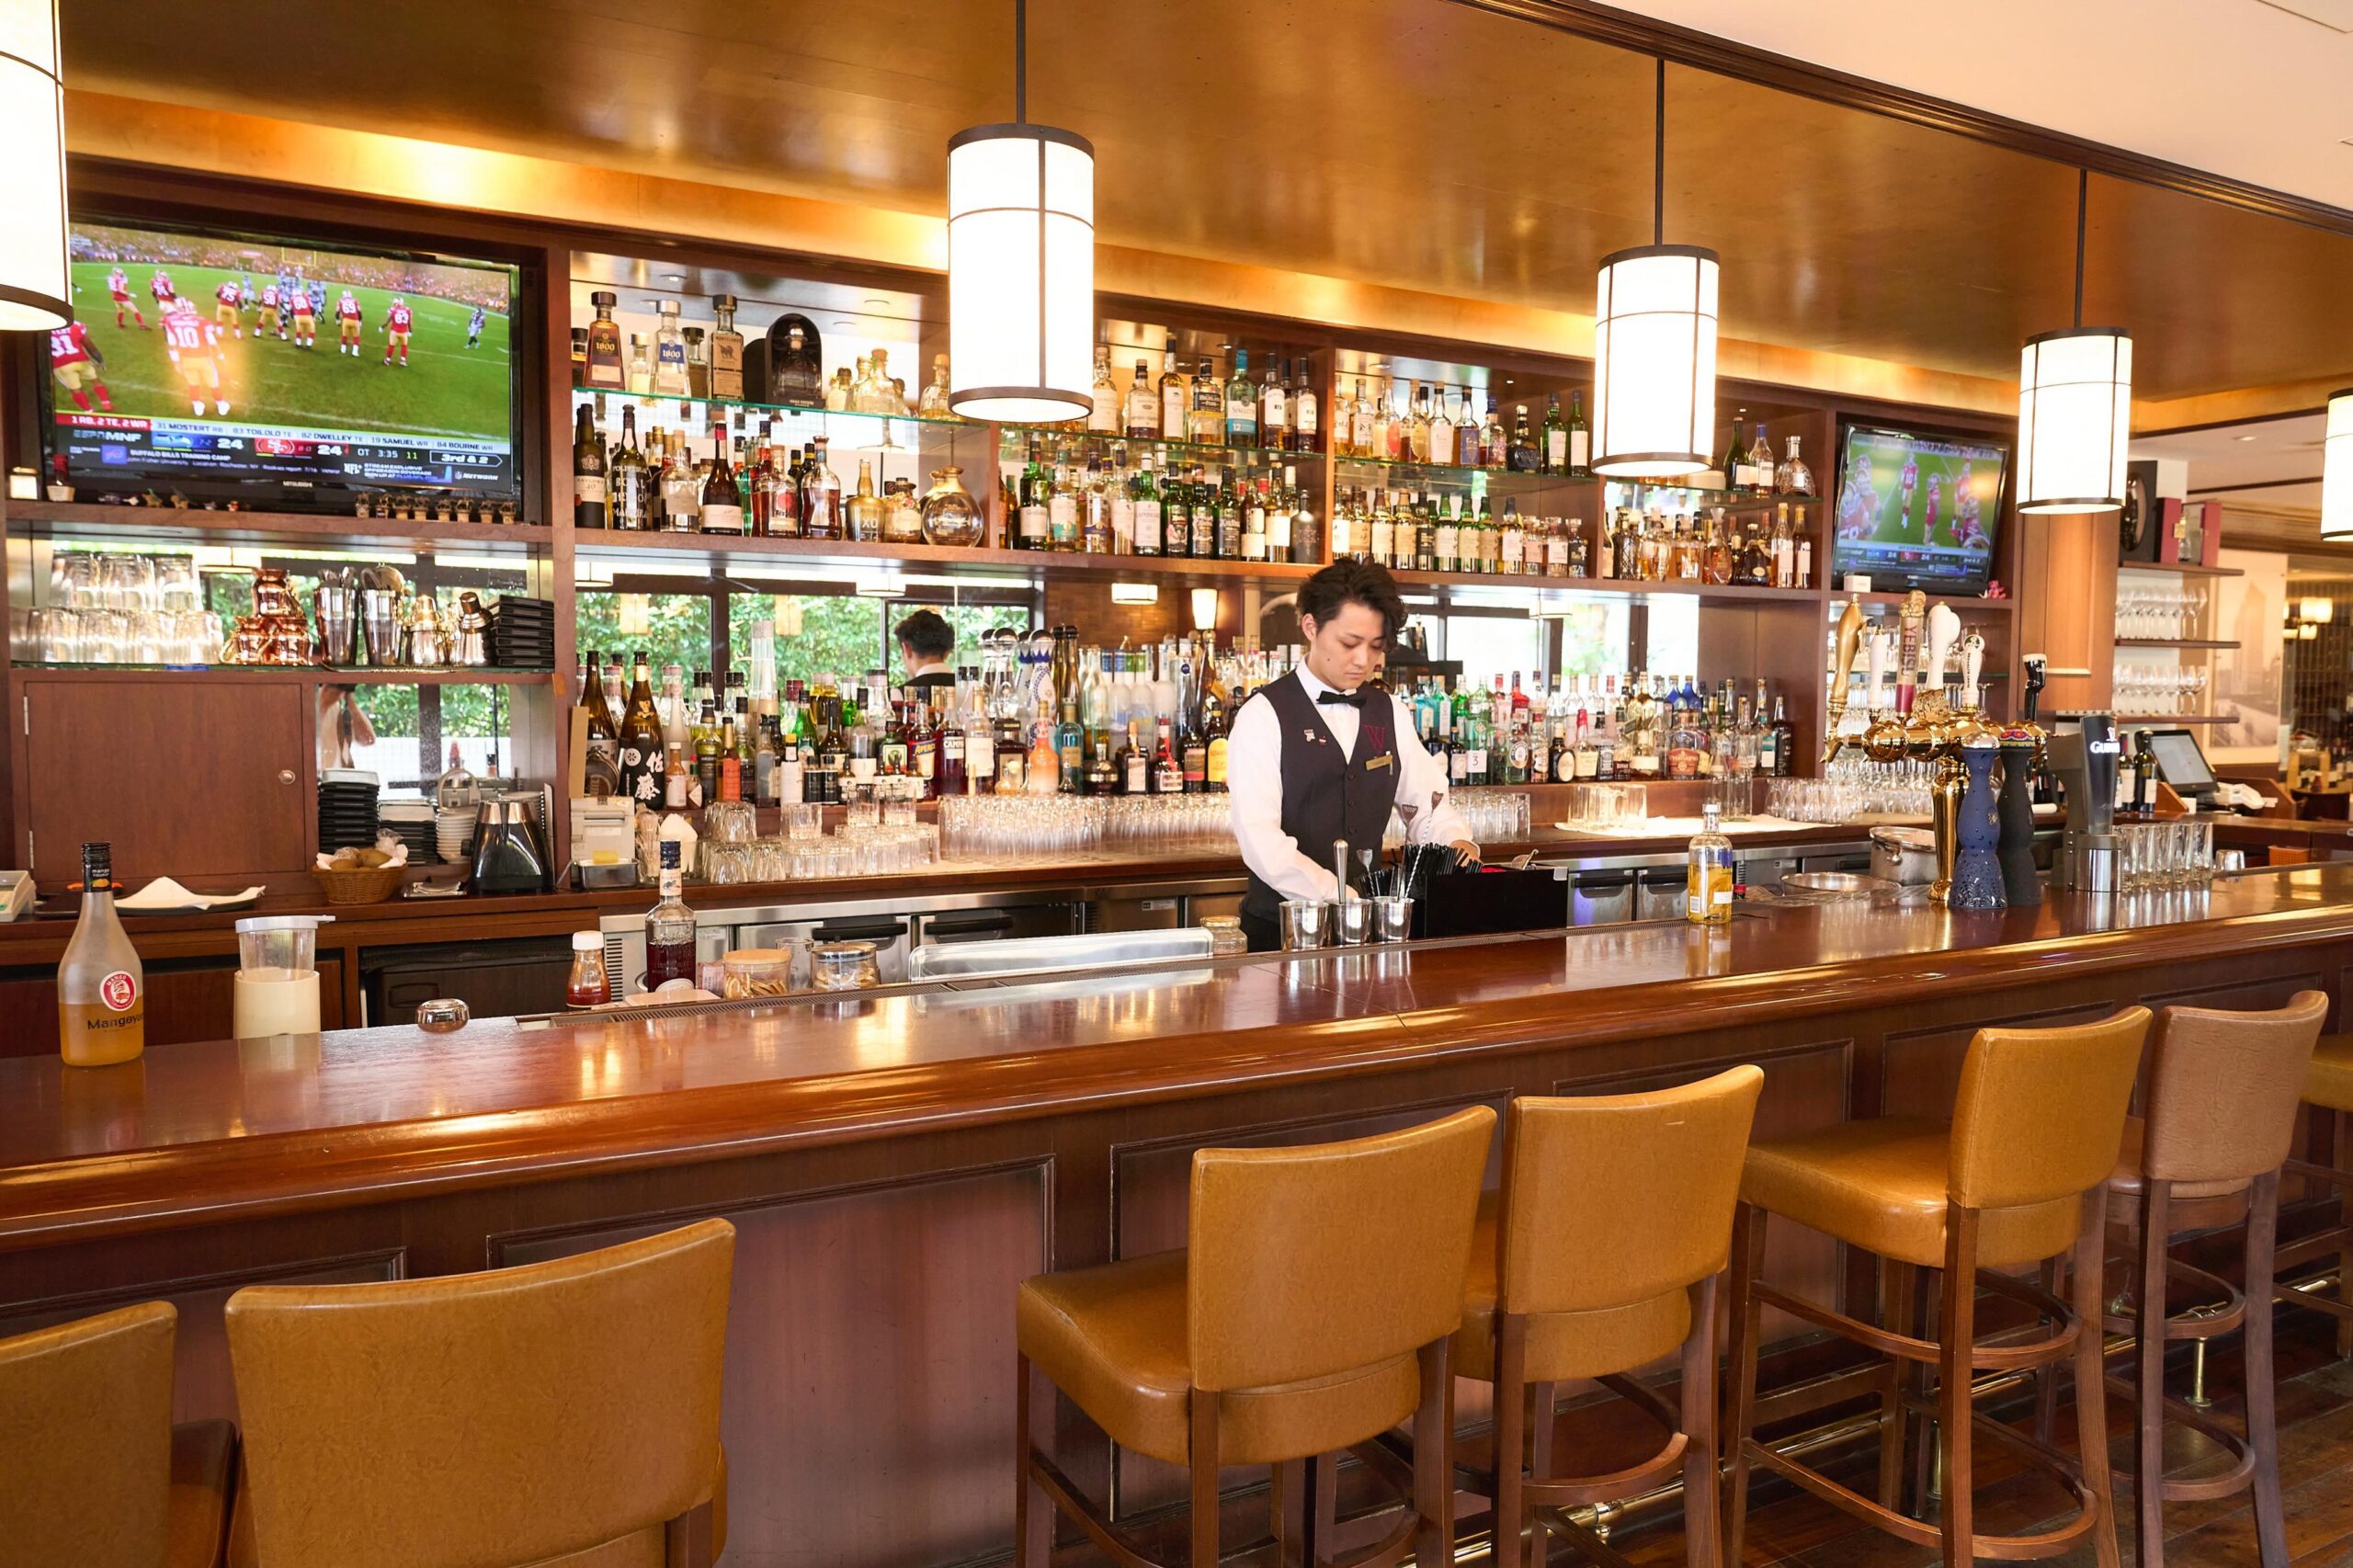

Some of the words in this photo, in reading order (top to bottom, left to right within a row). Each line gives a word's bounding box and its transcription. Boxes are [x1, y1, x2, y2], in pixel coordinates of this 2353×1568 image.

[343, 301, 357, 313] 69
[175, 327, 199, 348] 10
[596, 342, 615, 351] 1800
[662, 349, 681, 358] 1800
[131, 420, 147, 428] WR
[168, 424, 210, 432] MOSTERT
[314, 433, 353, 441] DWELLEY
[382, 437, 414, 446] SAMUEL
[217, 438, 244, 449] 24
[318, 445, 342, 456] 24
[441, 454, 465, 463] 3rd
[862, 518, 879, 528] XO
[1902, 625, 1917, 676] YEBISU
[915, 743, 936, 755] APERO
[1472, 756, 1478, 766] 3
[634, 750, 664, 801] 佐藤
[107, 974, 127, 986] MANGO
